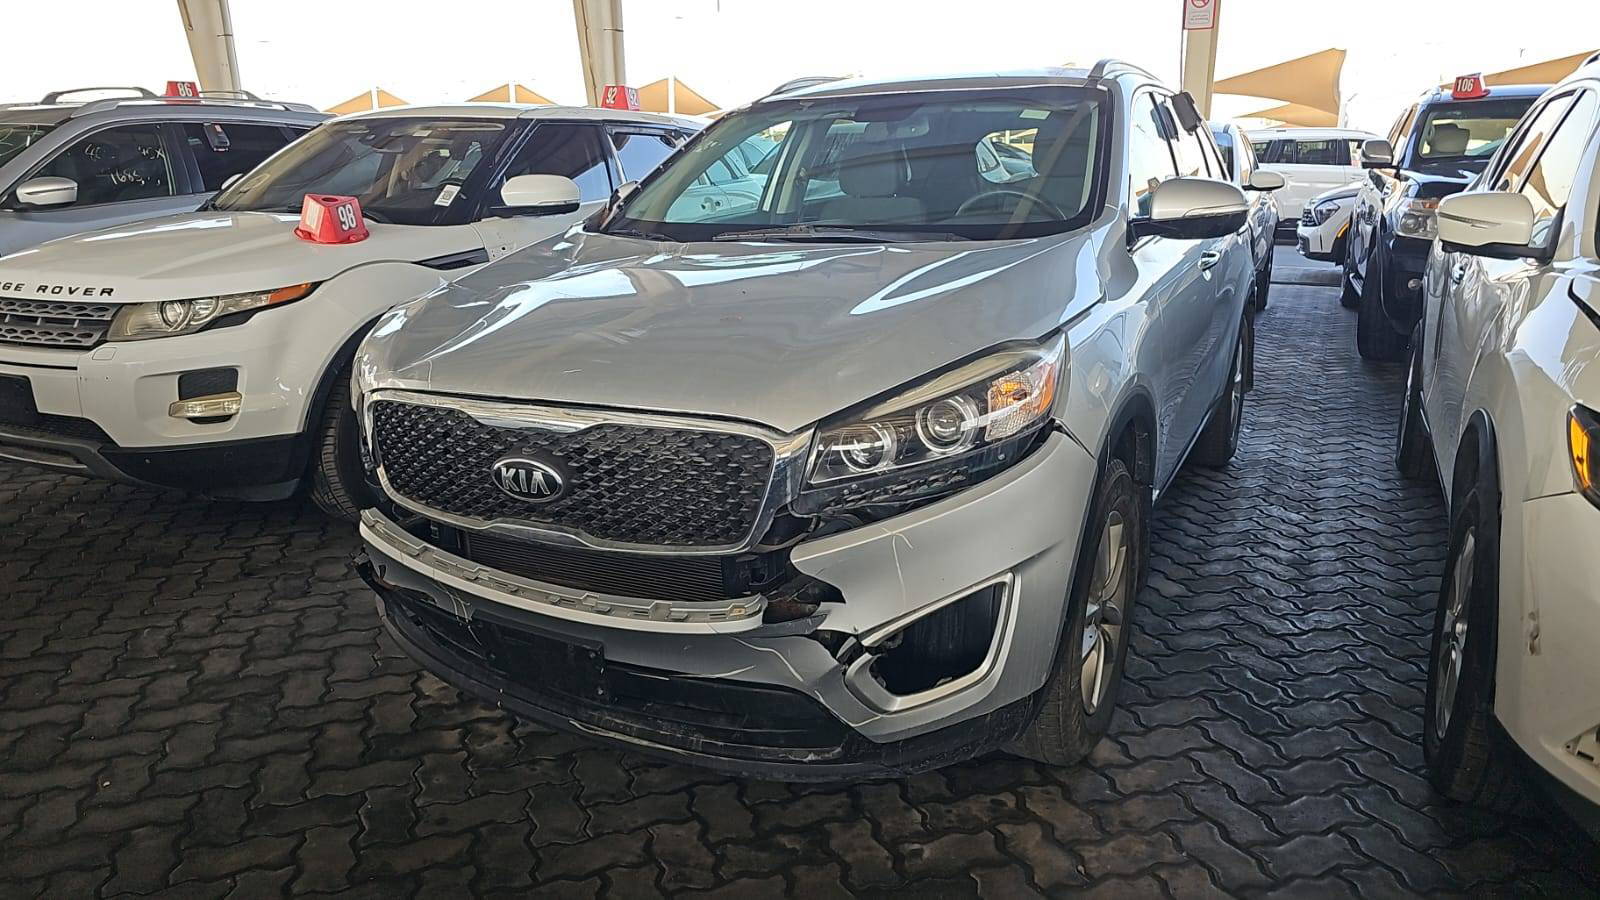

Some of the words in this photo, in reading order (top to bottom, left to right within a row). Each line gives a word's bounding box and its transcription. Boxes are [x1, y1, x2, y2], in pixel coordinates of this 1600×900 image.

[177, 82, 192, 97] 86
[1457, 79, 1474, 92] 106
[606, 87, 617, 104] 92
[338, 204, 357, 230] 98
[0, 282, 25, 292] GE
[36, 284, 114, 297] ROVER
[501, 467, 550, 494] KIA
